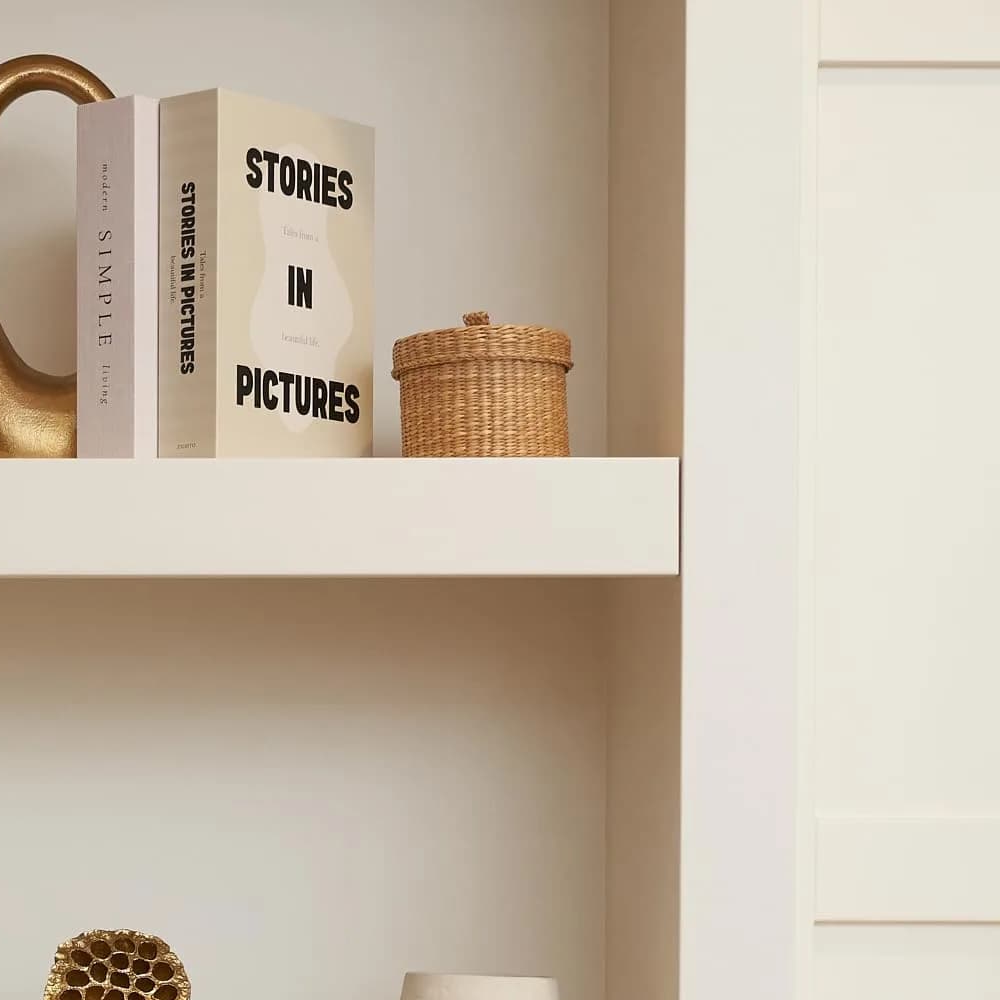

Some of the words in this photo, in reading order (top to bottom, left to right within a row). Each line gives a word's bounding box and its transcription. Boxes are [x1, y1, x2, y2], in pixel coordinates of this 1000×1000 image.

[102, 163, 111, 212] modern
[245, 147, 354, 210] STORIES
[181, 182, 196, 258] STORIES
[98, 230, 112, 347] SIMPLE
[181, 264, 195, 282] IN
[288, 265, 312, 309] IN
[179, 287, 195, 374] PICTURES
[100, 365, 111, 406] living
[236, 365, 360, 424] PICTURES
